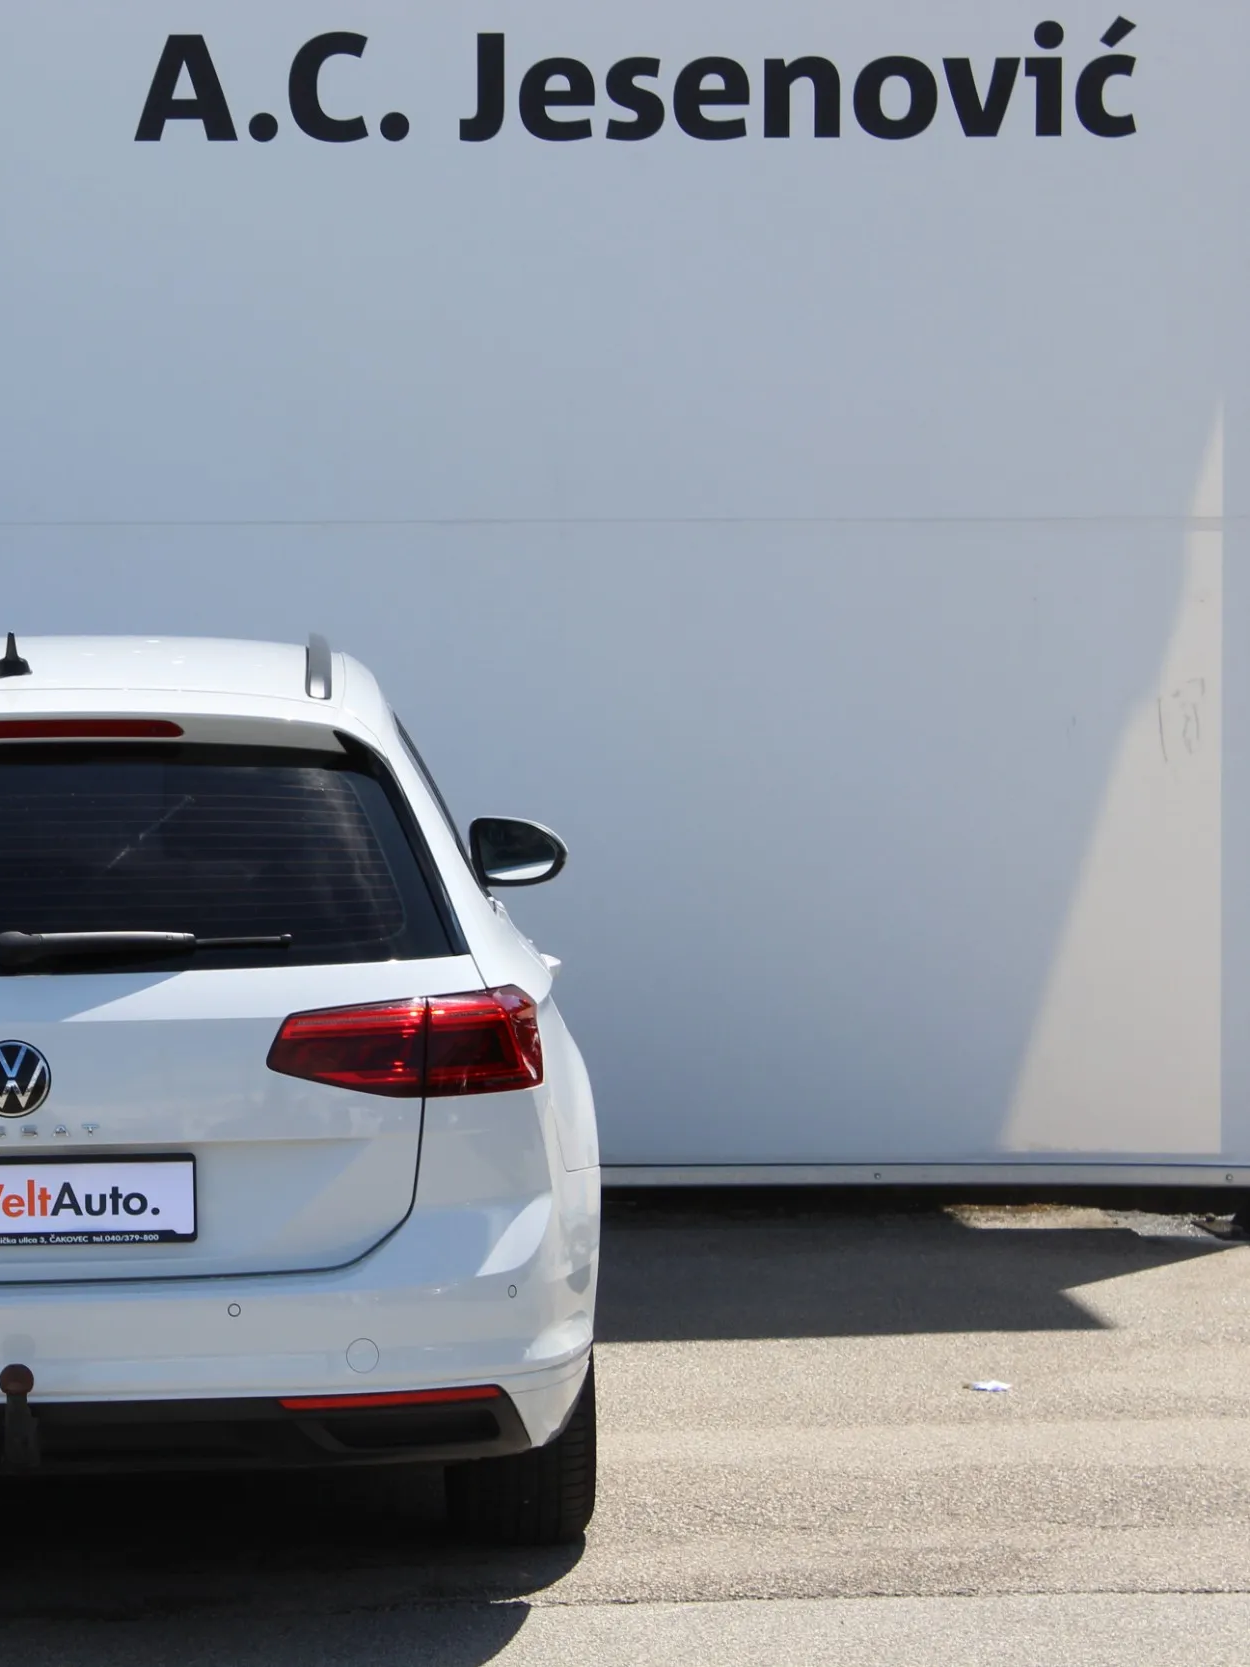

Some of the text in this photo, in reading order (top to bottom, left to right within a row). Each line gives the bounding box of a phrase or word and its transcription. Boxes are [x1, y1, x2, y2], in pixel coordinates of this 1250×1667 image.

[134, 15, 1138, 143] A.C. Jesenović
[18, 1235, 38, 1244] ulica
[49, 1233, 88, 1243] ČAKOVEC
